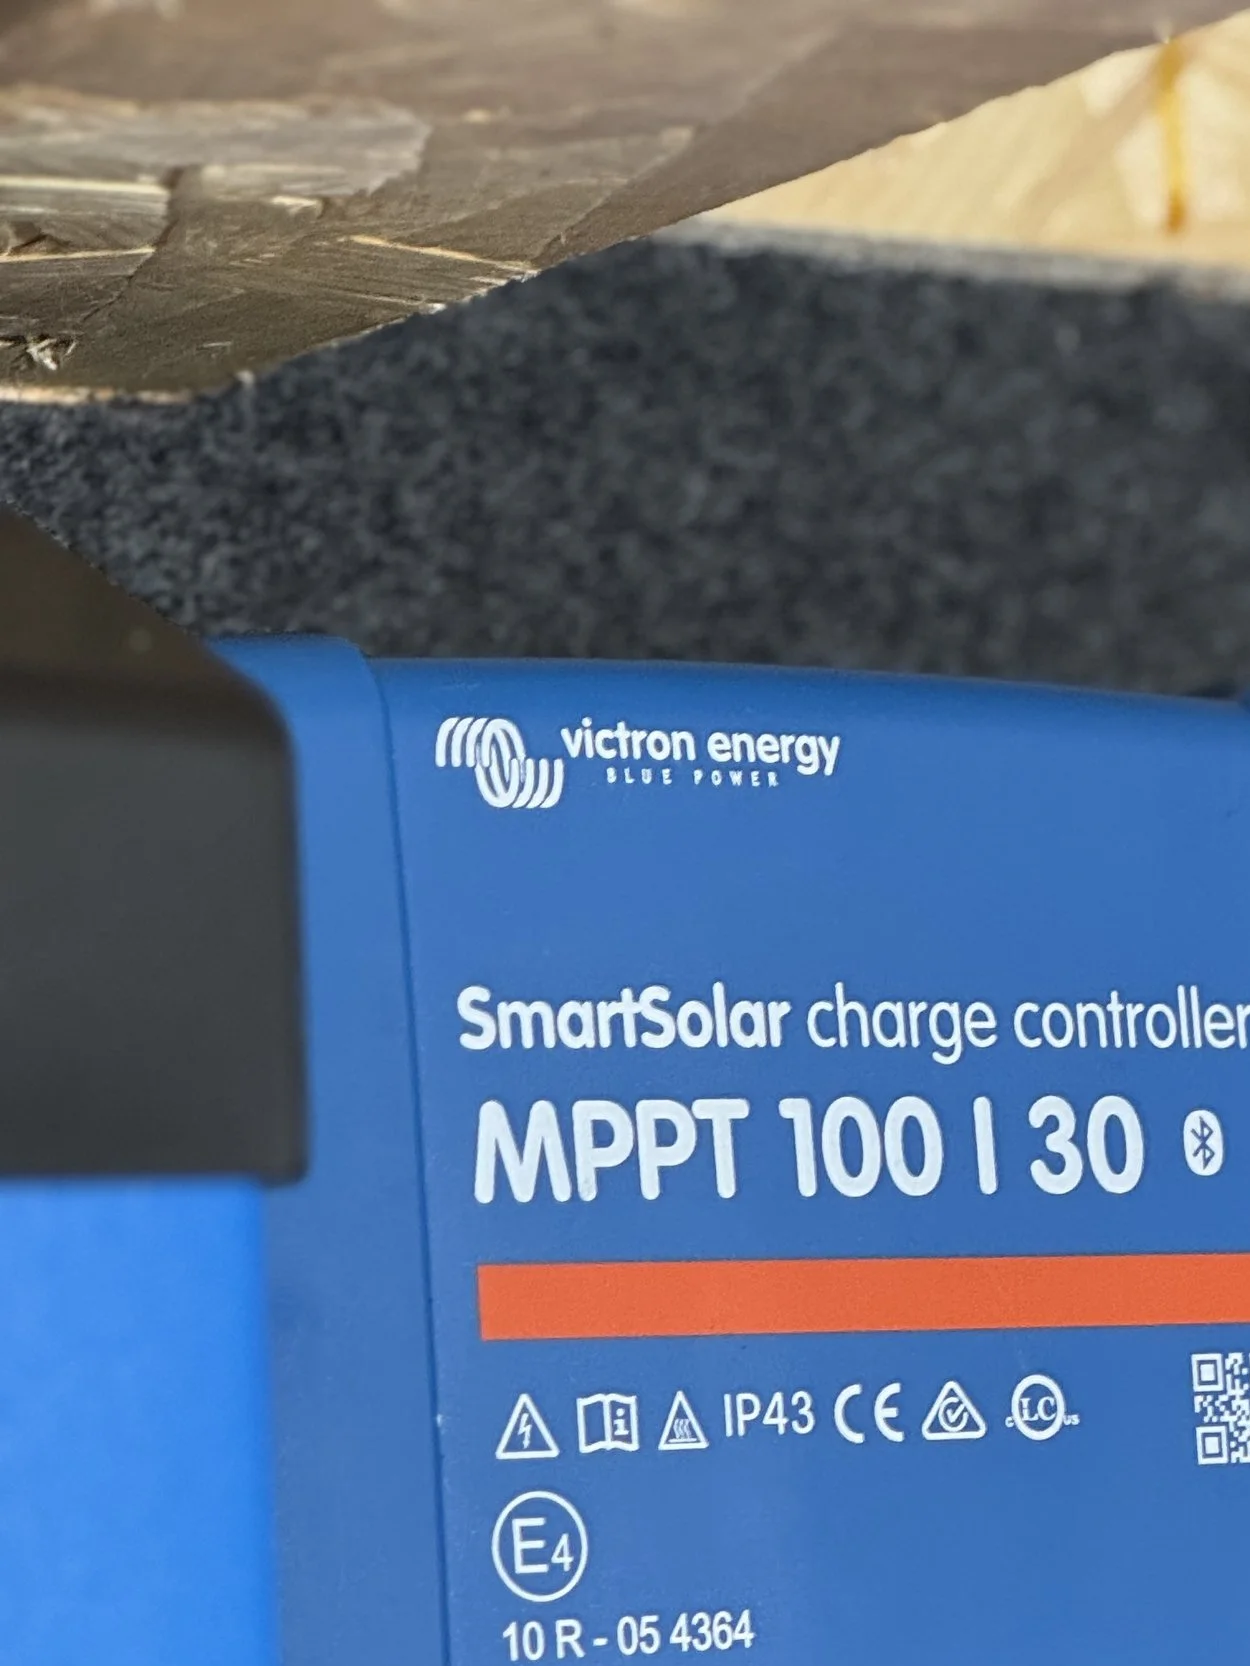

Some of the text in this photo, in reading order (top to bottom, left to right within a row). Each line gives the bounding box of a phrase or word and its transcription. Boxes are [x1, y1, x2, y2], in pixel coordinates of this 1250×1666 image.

[560, 717, 842, 777] victron energy
[606, 766, 778, 787] BLUE POWER
[456, 980, 792, 1051] SmartSolar
[806, 981, 999, 1066] charge
[473, 1097, 751, 1205] MPPT
[778, 1095, 944, 1199] 100
[1028, 1094, 1145, 1196] 30
[723, 1381, 905, 1445] IP43 CE
[511, 1516, 575, 1575] E4
[502, 1620, 546, 1662] 10
[555, 1618, 585, 1660] R
[616, 1614, 662, 1657] 05
[668, 1608, 756, 1653] 4364
